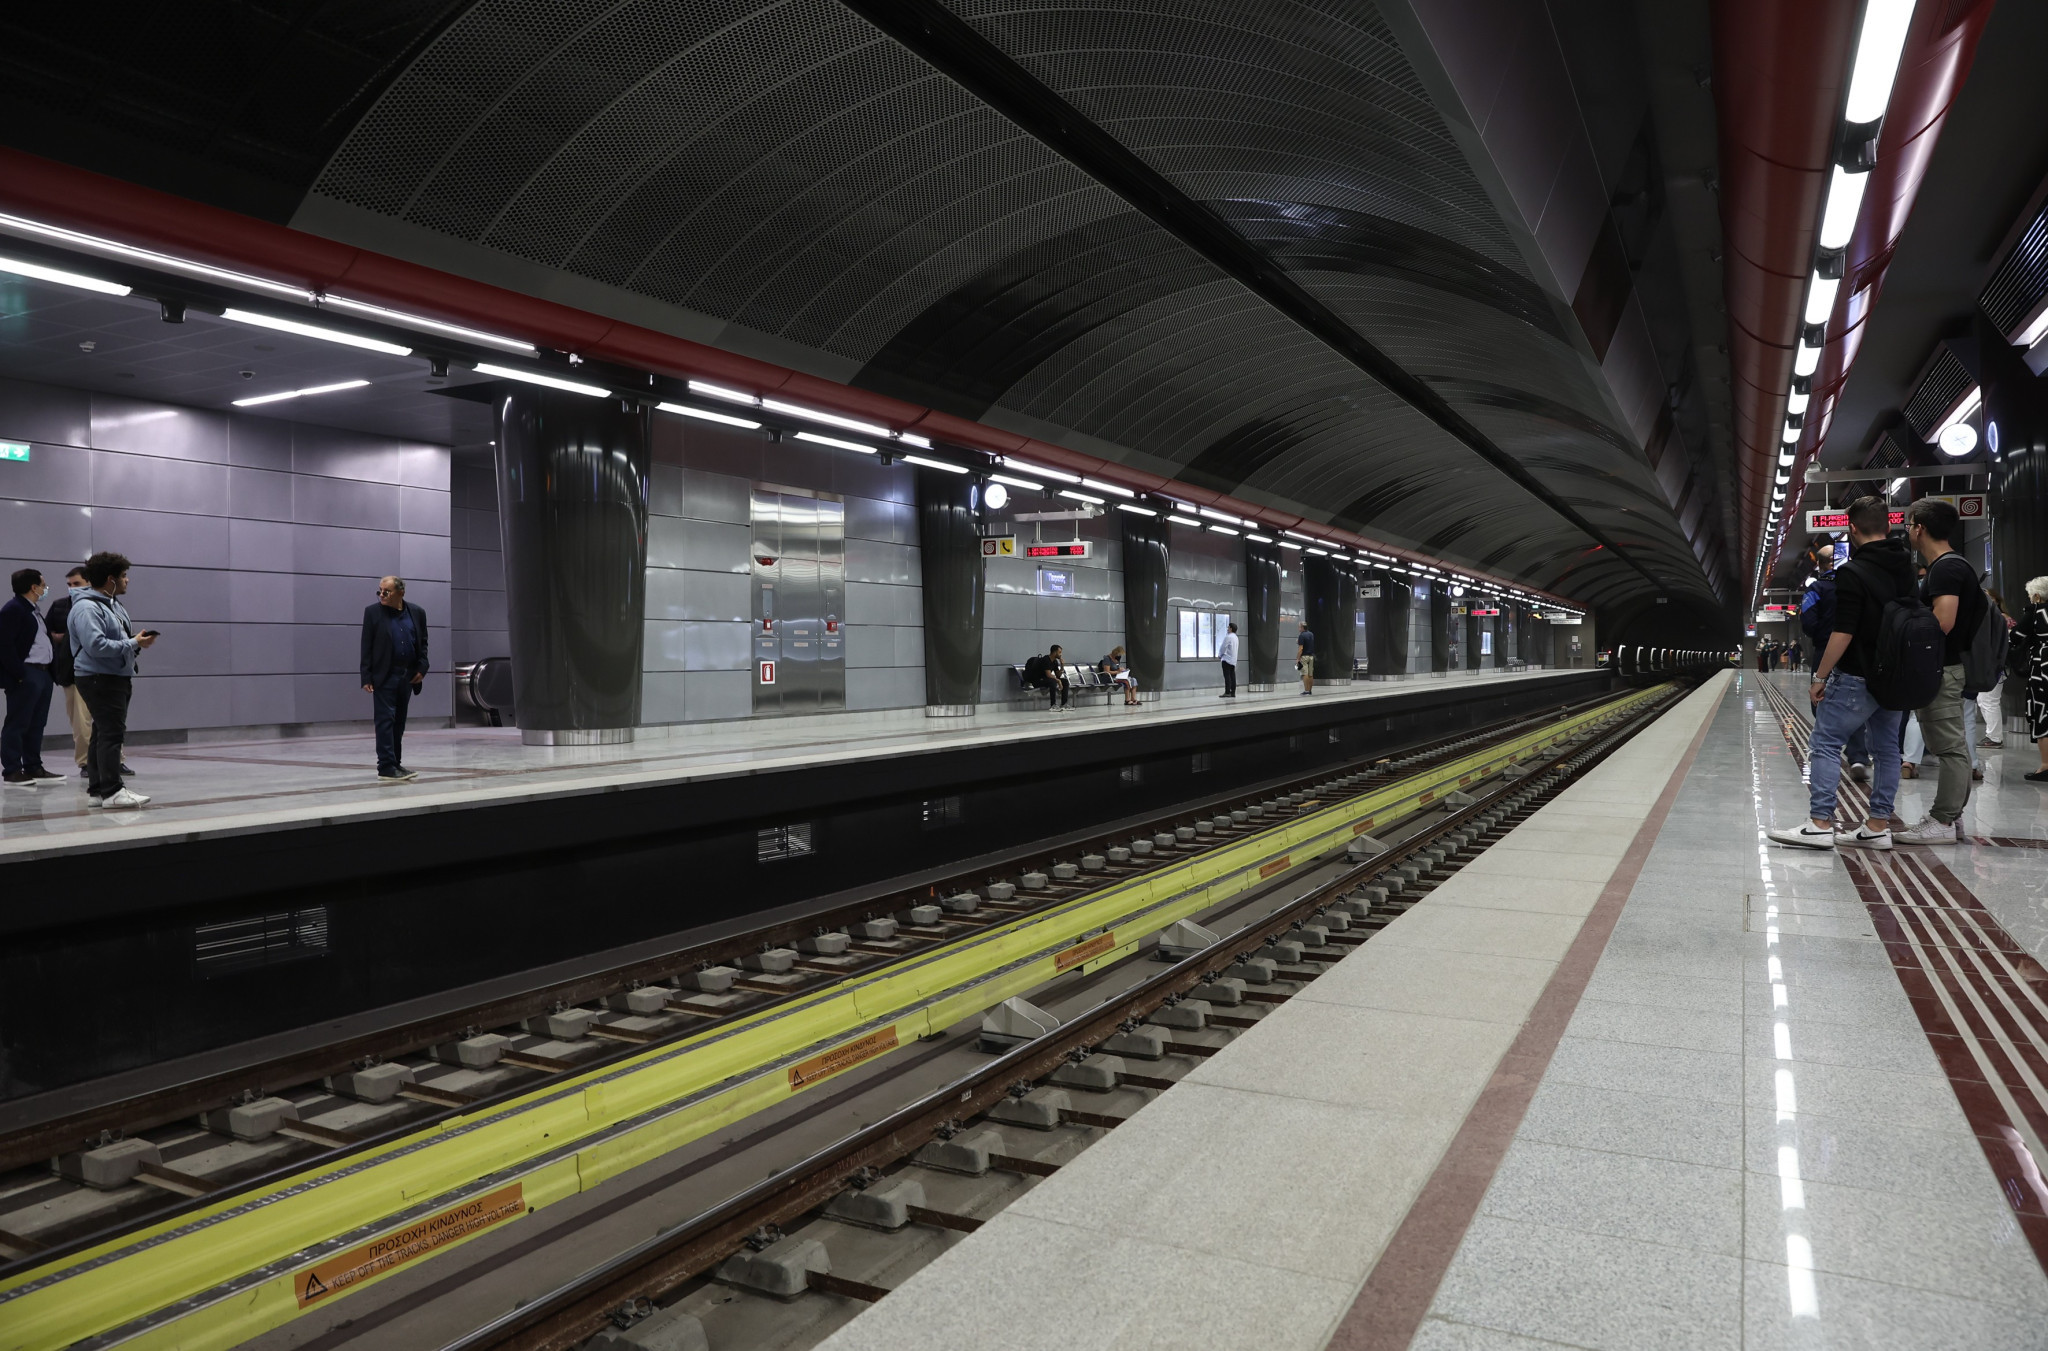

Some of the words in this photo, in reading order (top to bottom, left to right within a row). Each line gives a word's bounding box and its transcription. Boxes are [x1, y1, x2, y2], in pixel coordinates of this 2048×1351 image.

[331, 1269, 357, 1290] KEEP
[358, 1261, 379, 1279] OFF
[376, 1254, 396, 1270] THE
[431, 1224, 466, 1247] DANGER
[465, 1214, 486, 1232] HIGH
[483, 1200, 520, 1222] VOLTAGE
[369, 1225, 427, 1259] ΠΡΟΣΟΧΗ
[429, 1202, 485, 1234] ΚΙΝΔΥΝΟΣ
